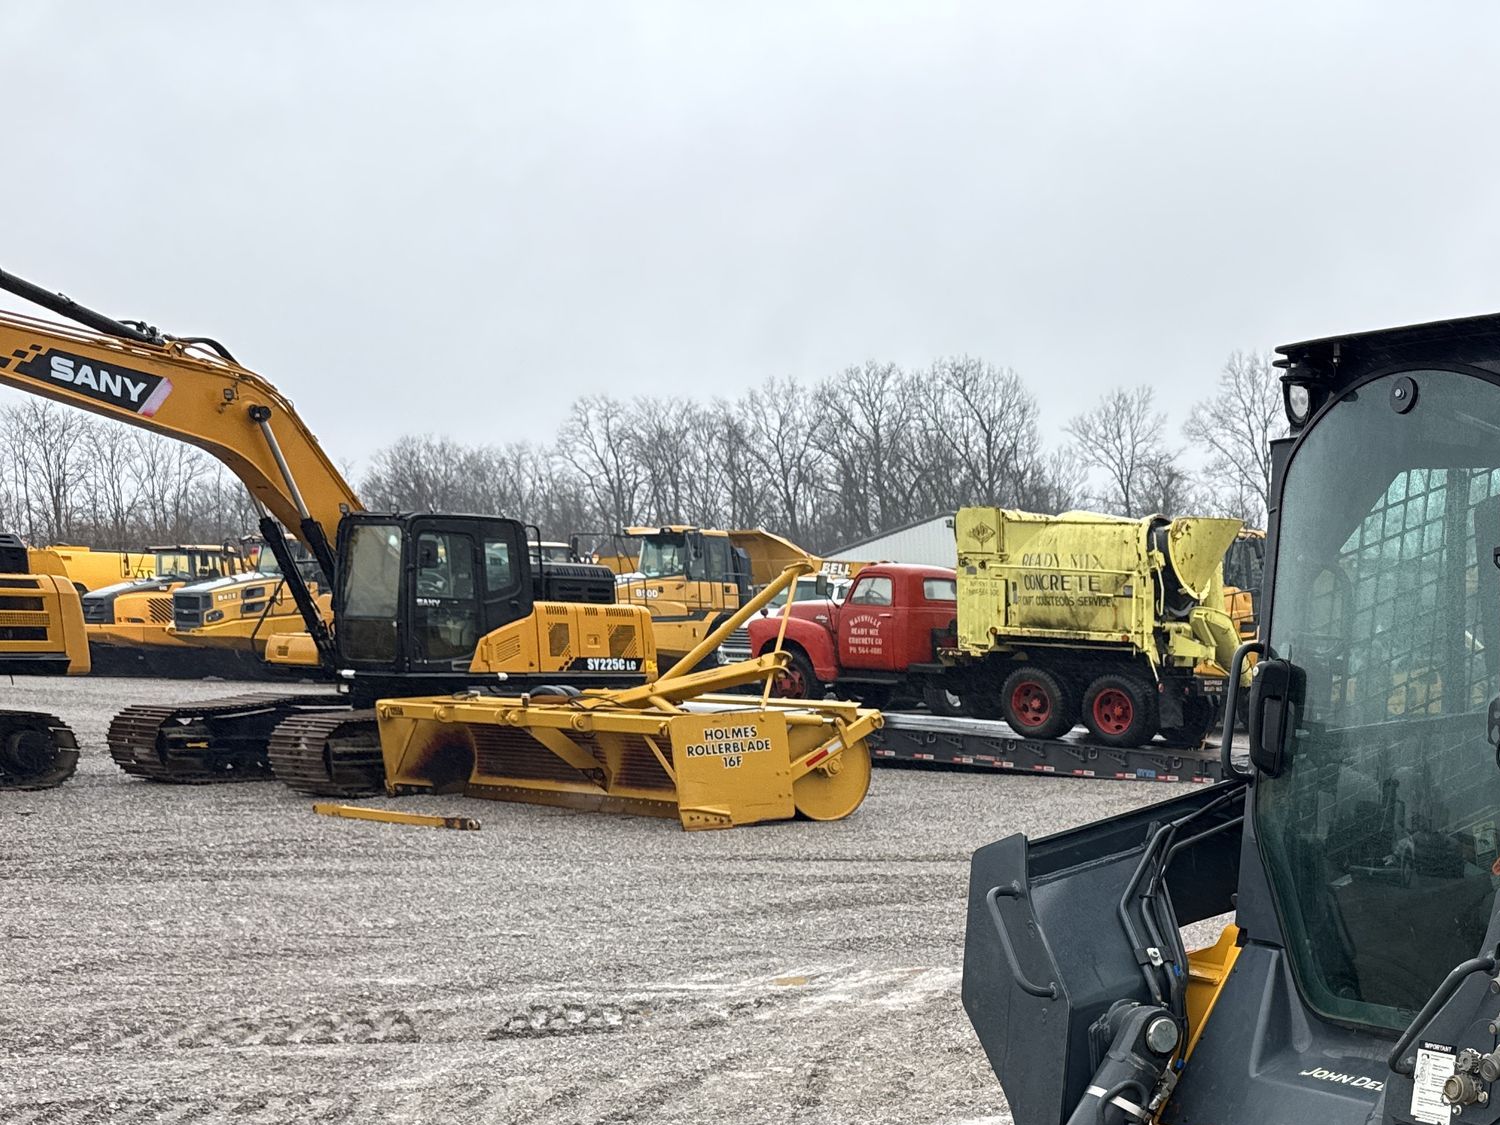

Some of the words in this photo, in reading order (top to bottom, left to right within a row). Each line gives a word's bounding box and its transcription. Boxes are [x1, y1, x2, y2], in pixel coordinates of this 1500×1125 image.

[50, 355, 148, 402] SANY
[821, 562, 852, 575] BELL
[1024, 574, 1101, 592] CONCRETE
[1077, 595, 1112, 608] SERVICE
[849, 615, 882, 628] MAYSVILLE
[851, 627, 868, 635] READY
[869, 628, 879, 636] MIX
[848, 636, 874, 645] CONCRETE
[587, 658, 625, 671] SY225C
[626, 660, 637, 671] LC
[704, 726, 757, 741] HOLMES
[686, 739, 771, 757] ROLLERBLADE
[723, 755, 742, 768] 16F
[1424, 1041, 1453, 1053] IMPORTANT
[1298, 1066, 1355, 1084] JOHN
